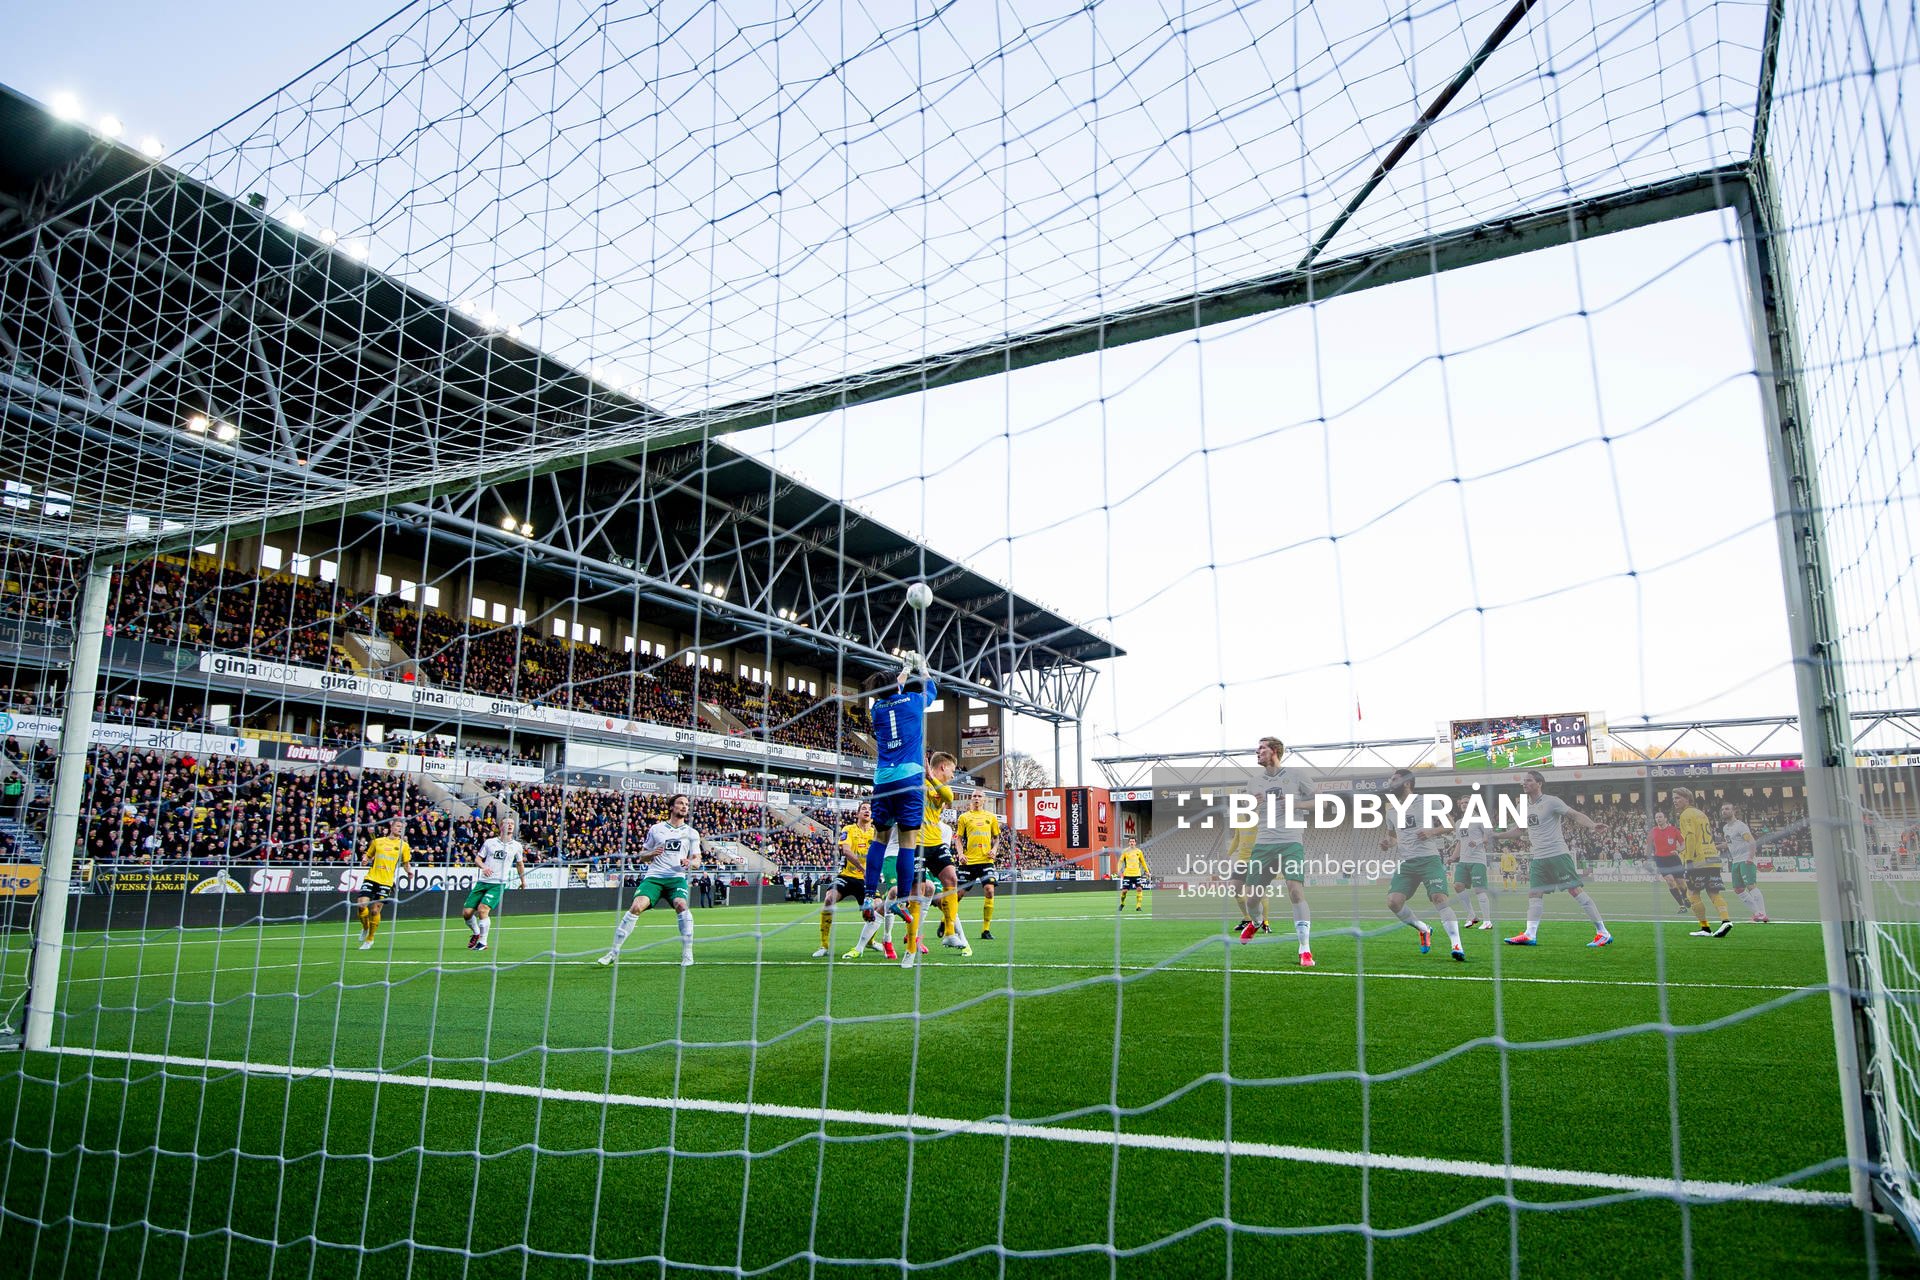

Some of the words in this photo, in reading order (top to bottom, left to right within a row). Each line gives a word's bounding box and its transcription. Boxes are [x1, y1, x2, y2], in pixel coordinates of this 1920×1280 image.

[888, 710, 898, 739] 1
[1555, 723, 1562, 733] 0
[1573, 722, 1580, 731] 0
[1556, 735, 1581, 745] 10:11
[1717, 762, 1777, 773] PULSEN
[720, 788, 738, 799] TEAM
[120, 873, 143, 881] MED
[145, 873, 172, 881] SMAK
[174, 872, 200, 881] FRÅN
[110, 883, 153, 891] SVENSKA
